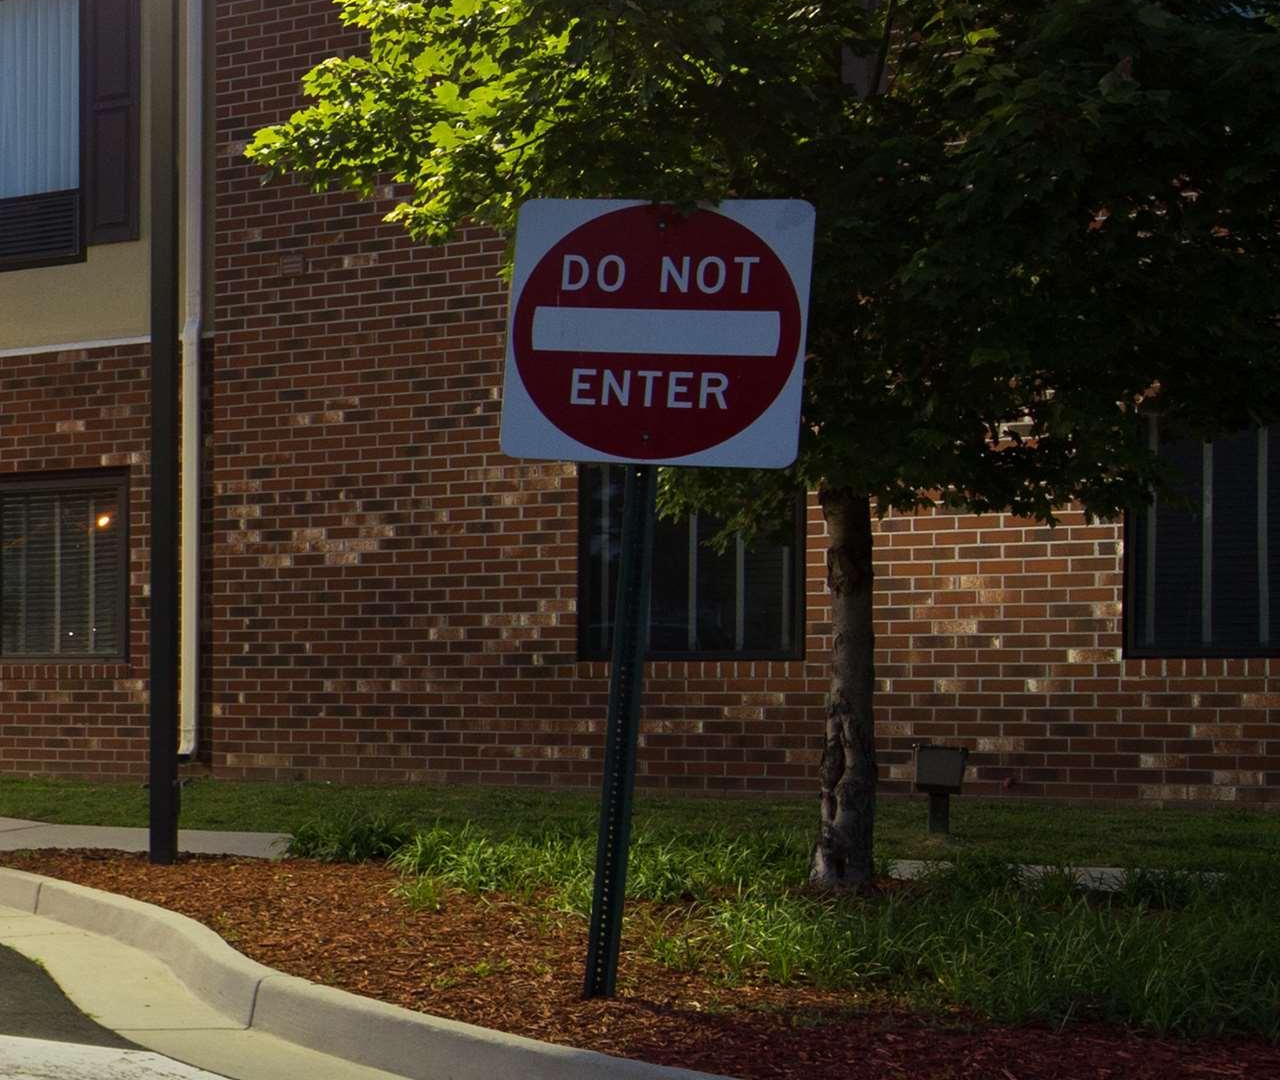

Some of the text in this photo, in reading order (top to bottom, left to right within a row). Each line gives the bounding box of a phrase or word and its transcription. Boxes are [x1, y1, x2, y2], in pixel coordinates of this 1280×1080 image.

[561, 254, 760, 294] DO NOT
[570, 368, 729, 410] ENTER
